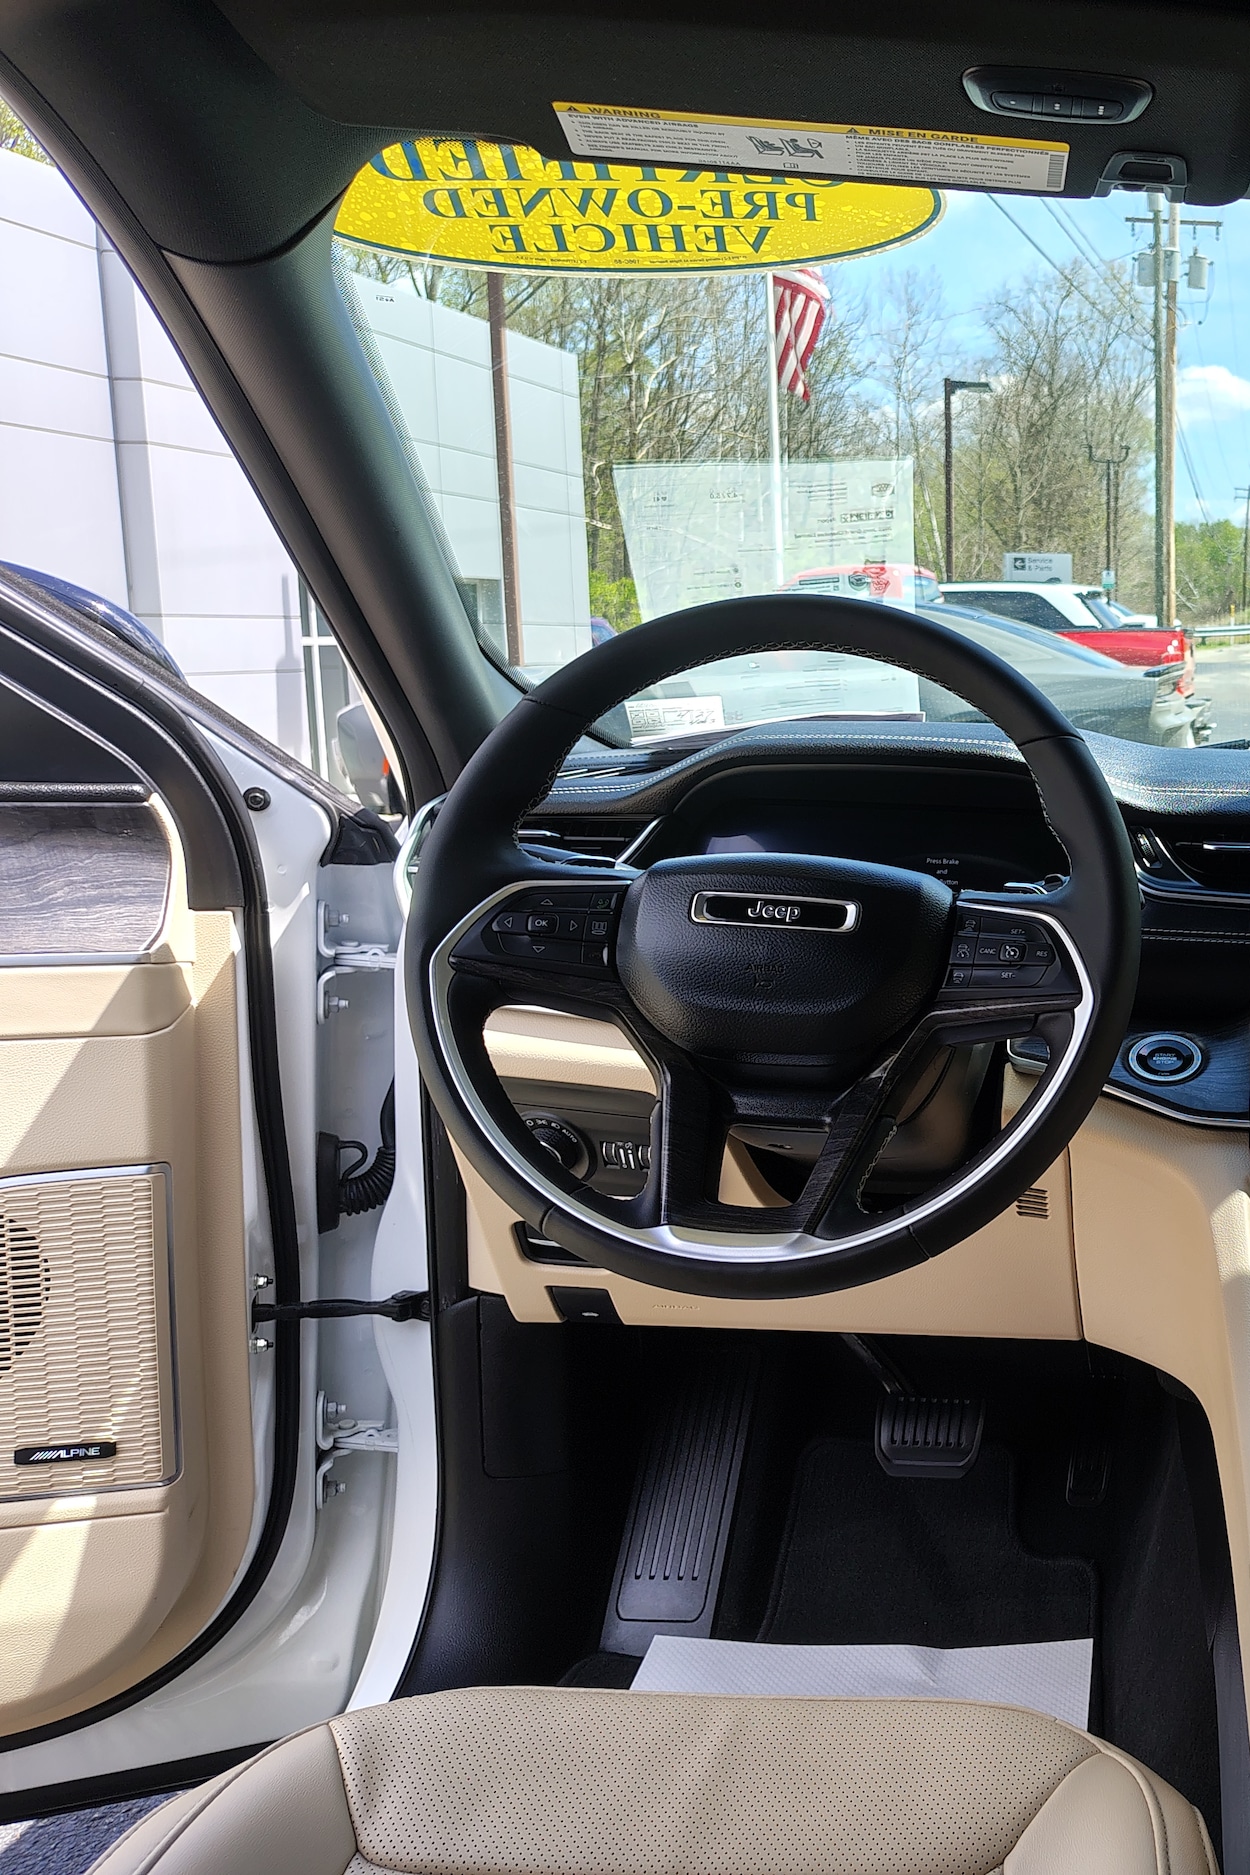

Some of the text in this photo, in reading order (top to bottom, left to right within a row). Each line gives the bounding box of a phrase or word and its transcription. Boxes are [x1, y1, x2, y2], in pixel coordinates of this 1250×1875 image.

[587, 107, 660, 119] WARNING
[615, 117, 660, 125] ADVANCED
[868, 128, 977, 143] MISE EN GARDE
[932, 141, 985, 150] GONFLABLES
[986, 145, 1049, 156] PERFECTIONNÉS
[926, 857, 960, 866] Press Brake
[747, 899, 801, 923] Jeep
[534, 919, 549, 927] OK
[979, 947, 997, 955] CANC
[561, 1129, 578, 1143] AUTO
[50, 1446, 101, 1460] ALPINE
